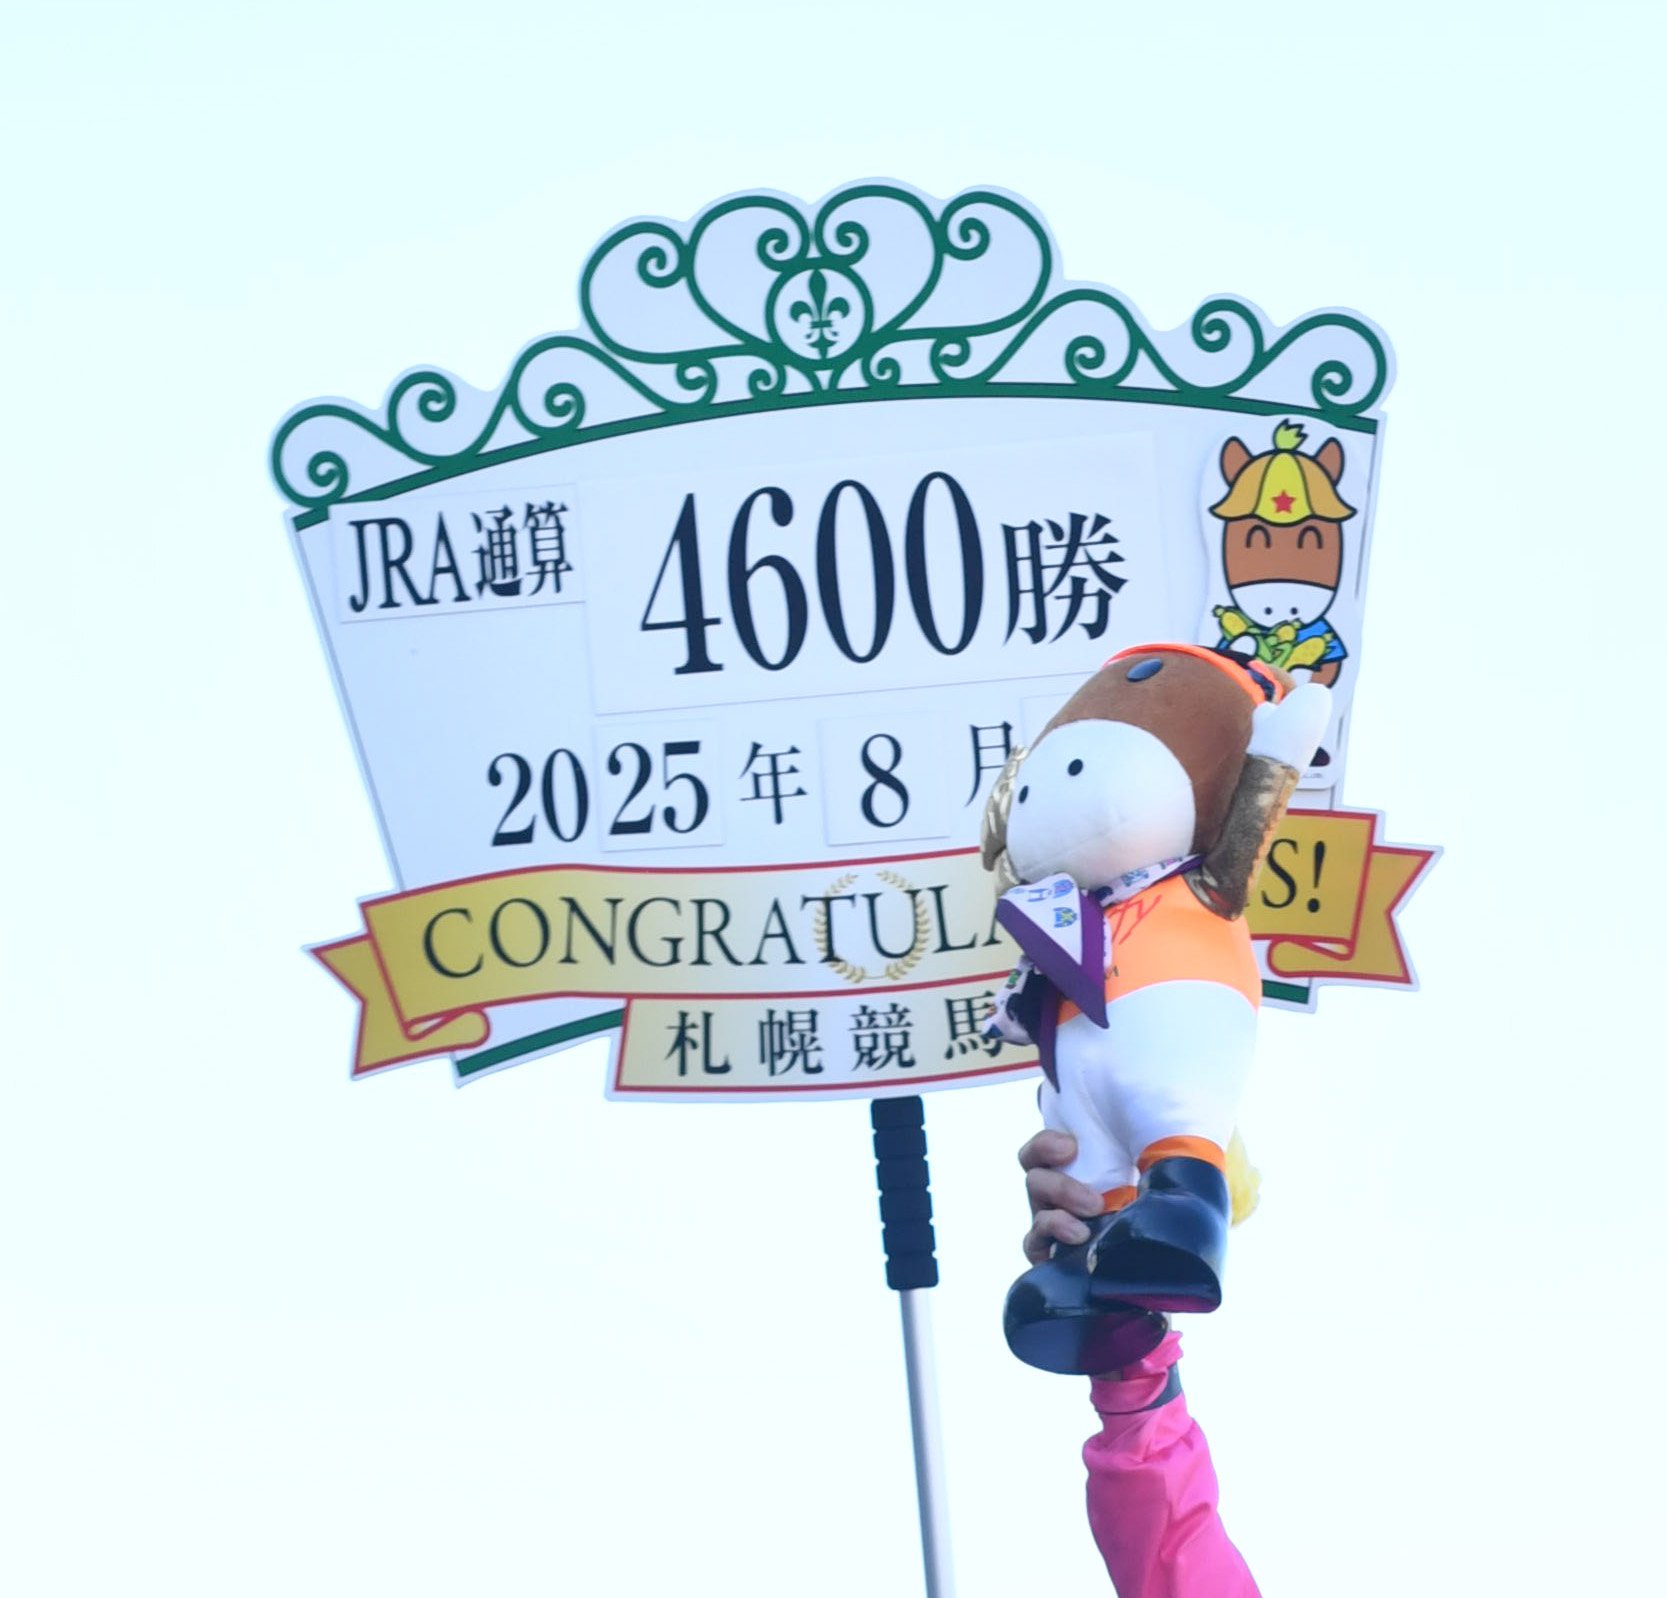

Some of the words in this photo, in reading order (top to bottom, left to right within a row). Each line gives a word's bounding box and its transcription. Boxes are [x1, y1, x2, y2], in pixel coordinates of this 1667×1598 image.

[347, 500, 574, 614] JRA通算
[639, 470, 1130, 676] 4600勝
[664, 990, 1004, 1078] 札幌競馬
